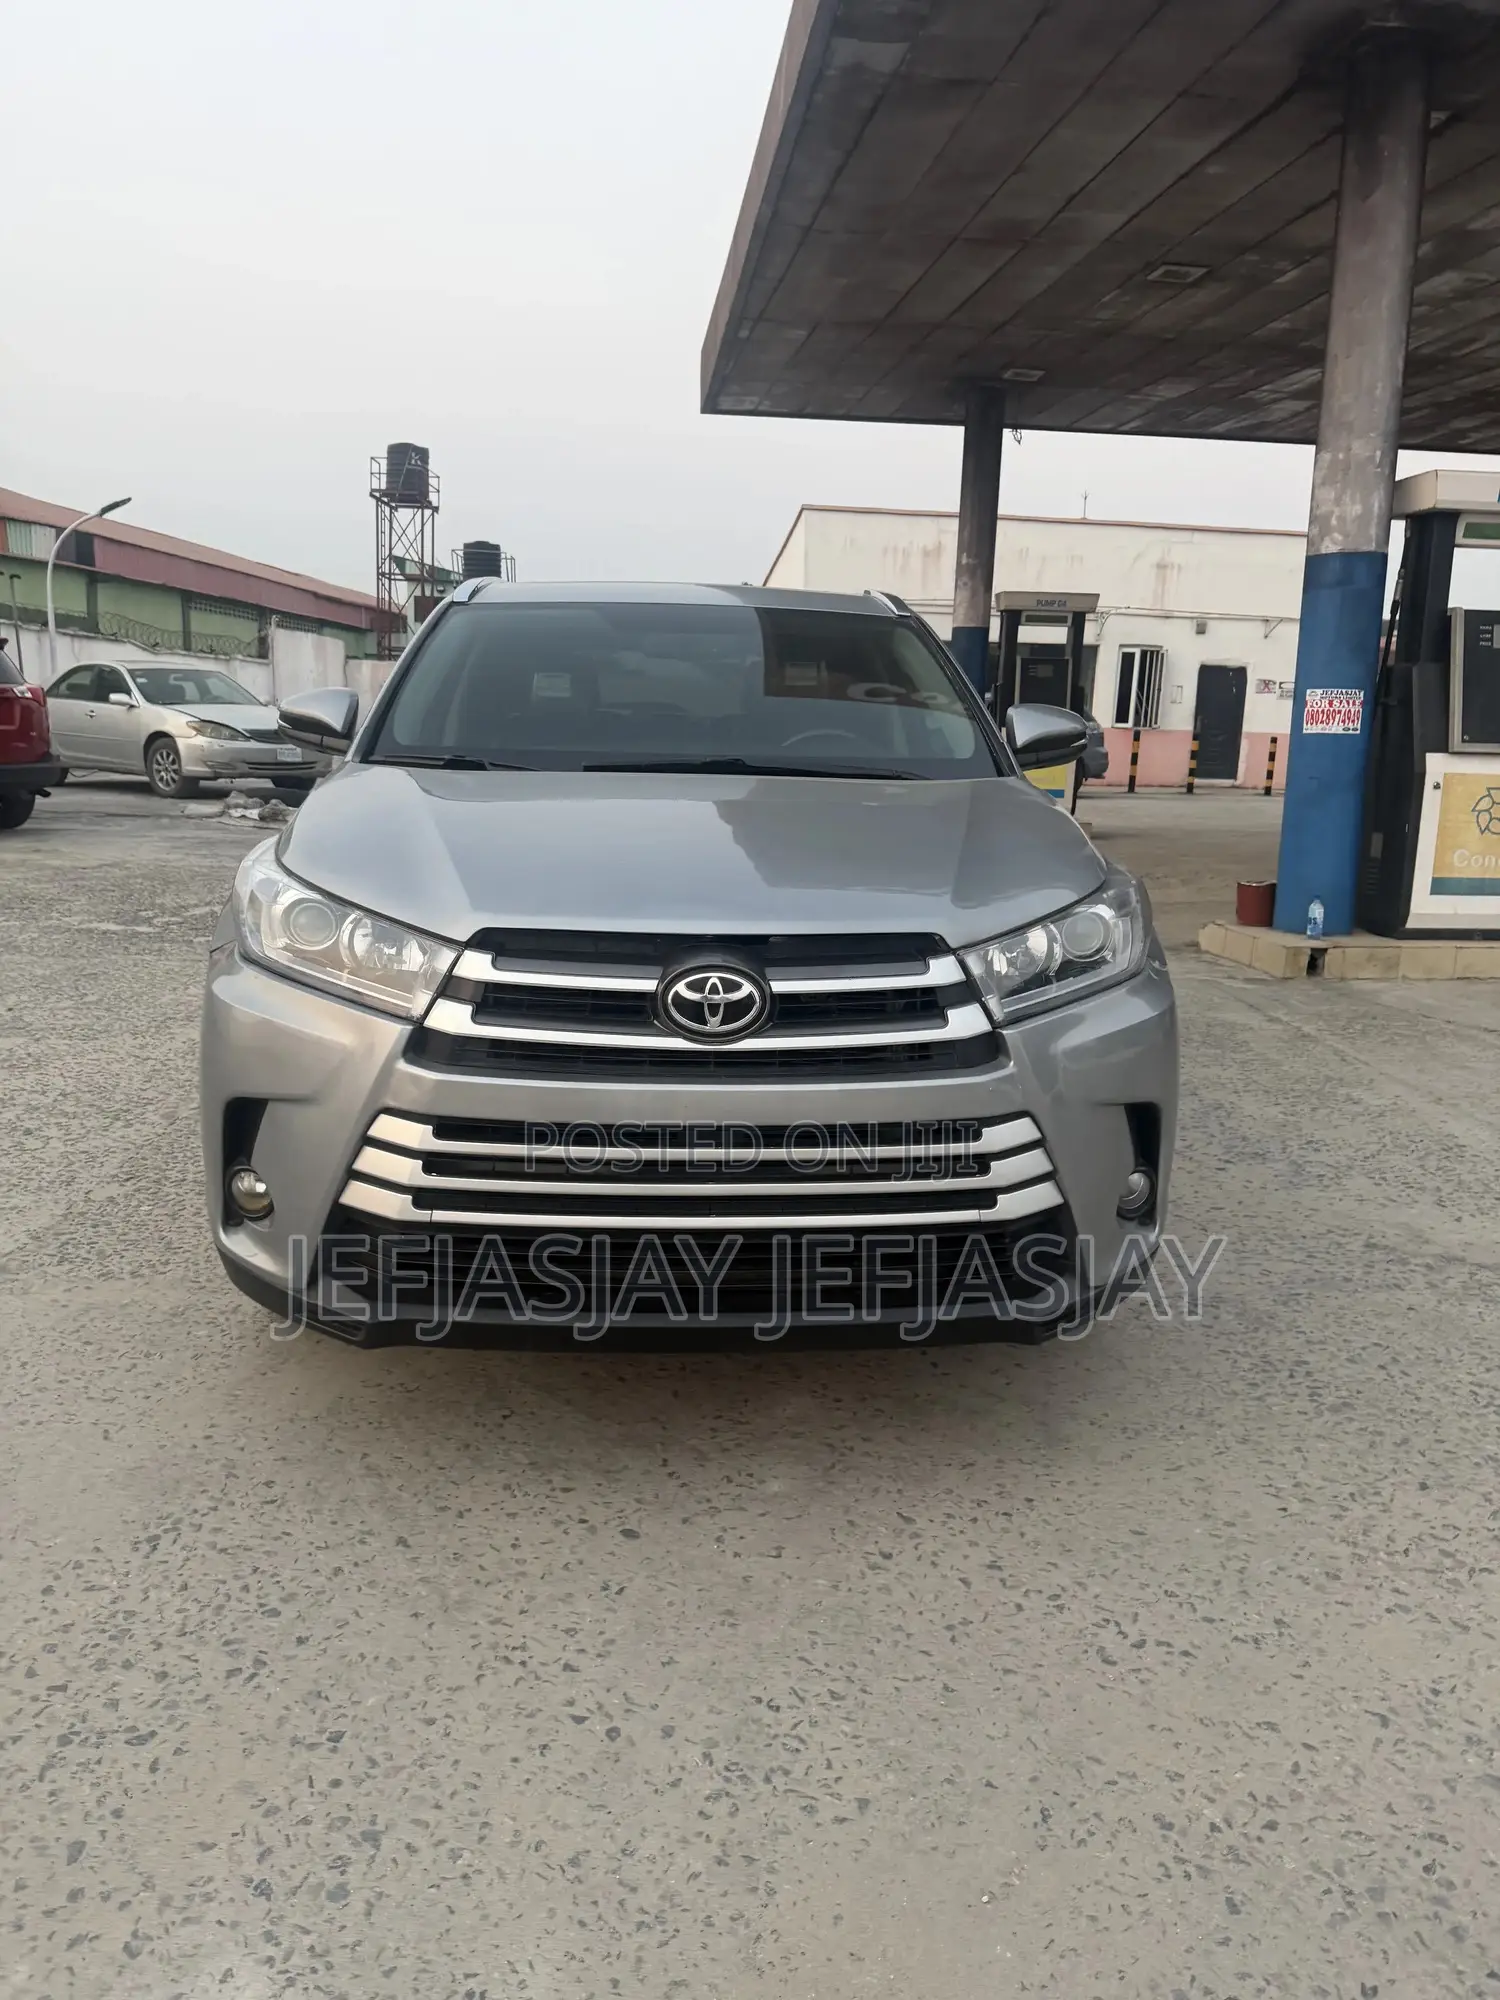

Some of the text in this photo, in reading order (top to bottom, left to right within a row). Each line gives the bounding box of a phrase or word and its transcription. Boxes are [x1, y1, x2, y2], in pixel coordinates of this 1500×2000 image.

[1307, 700, 1361, 709] FOR SALE
[1305, 709, 1361, 726] 08028974949
[1453, 848, 1500, 868] Con
